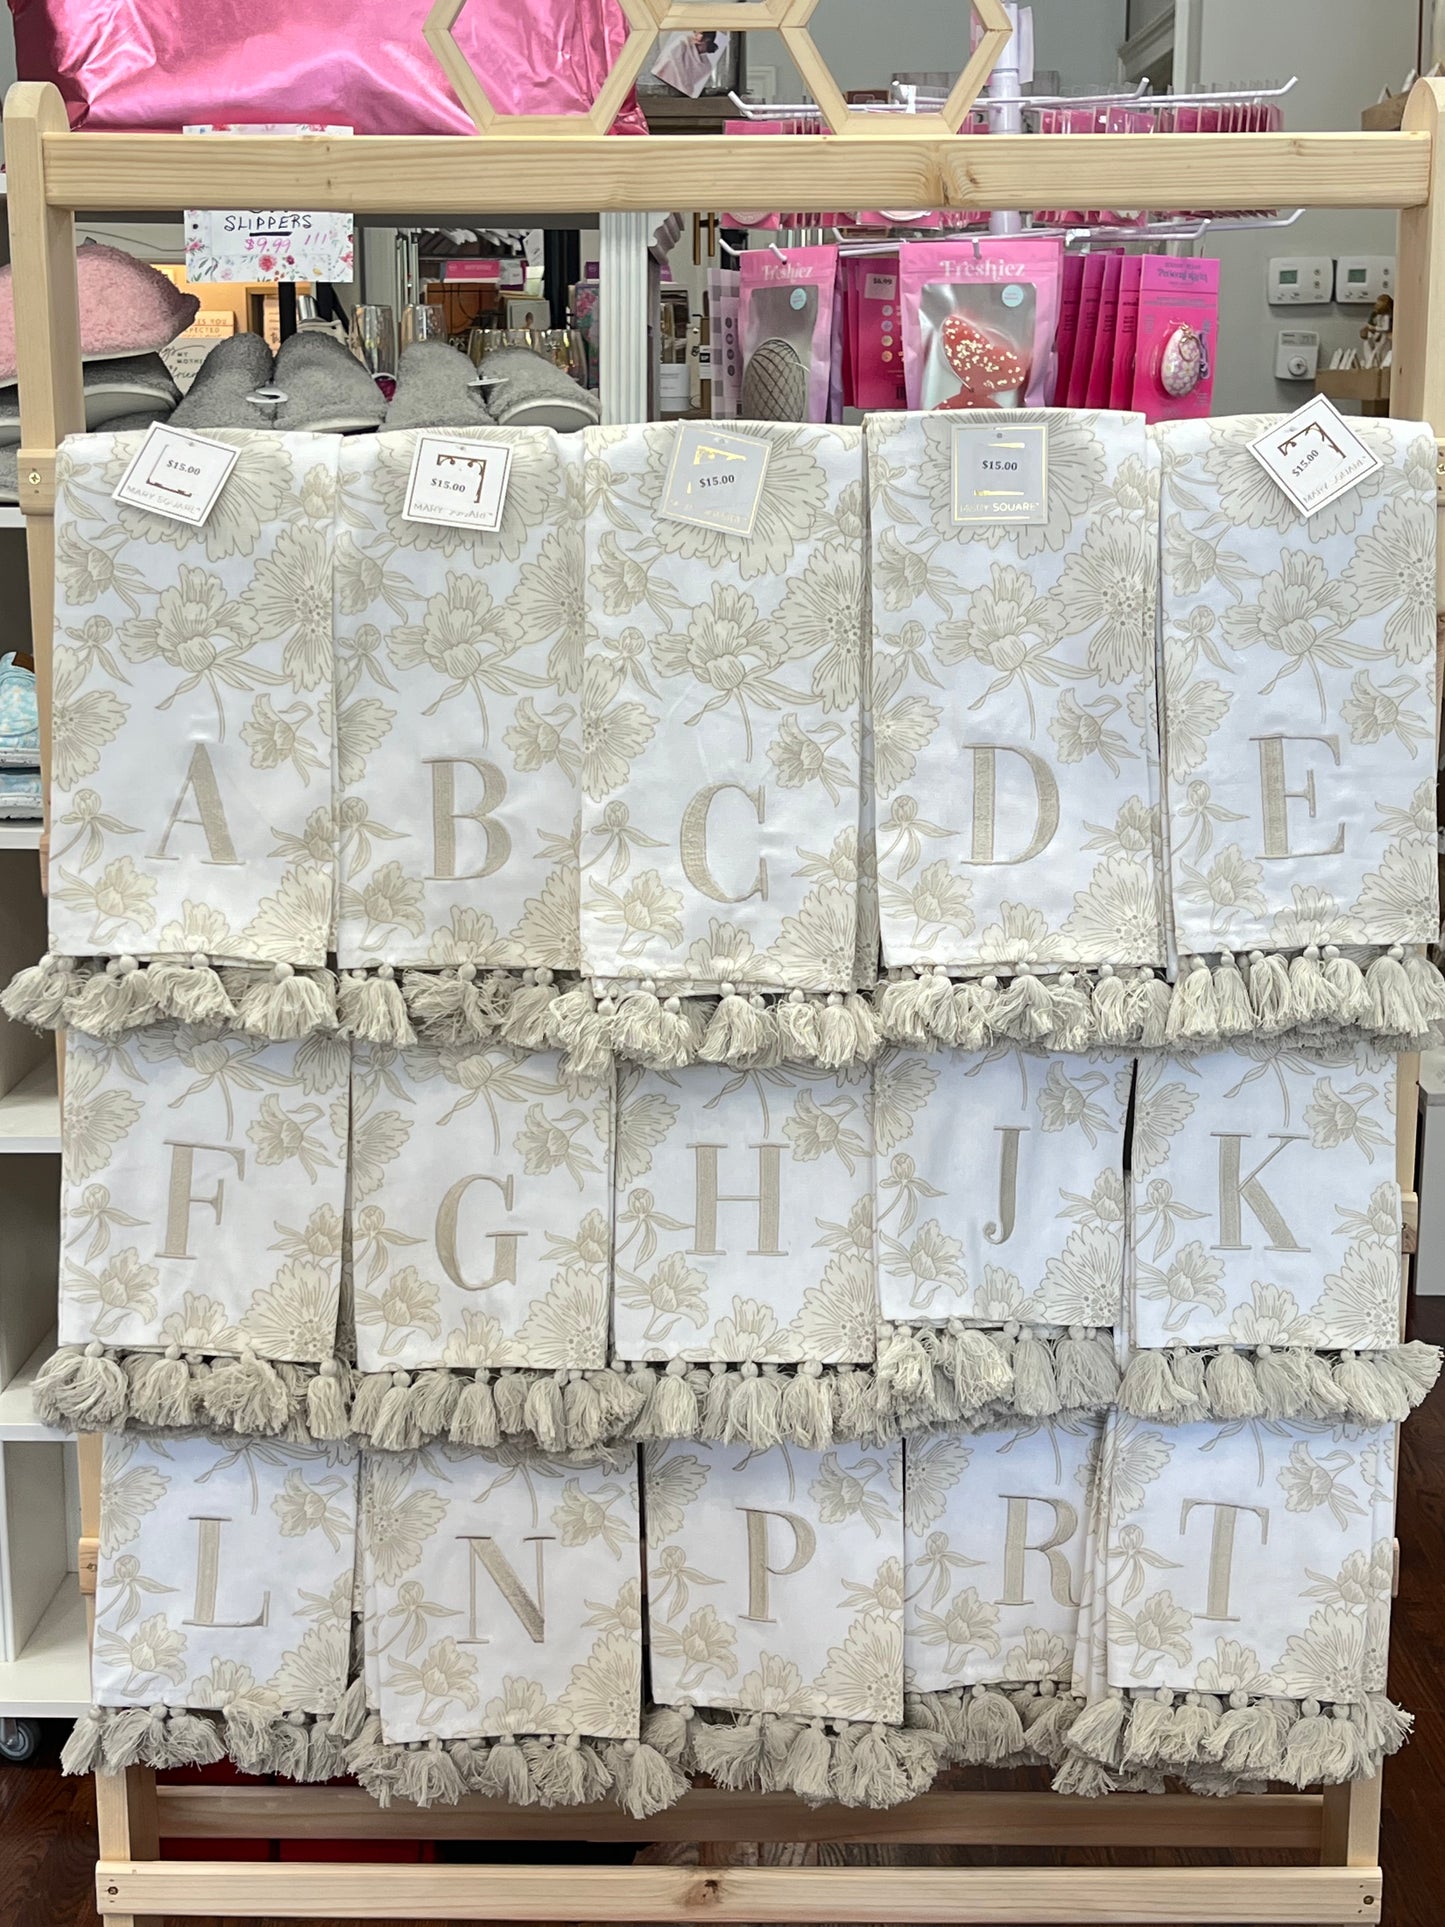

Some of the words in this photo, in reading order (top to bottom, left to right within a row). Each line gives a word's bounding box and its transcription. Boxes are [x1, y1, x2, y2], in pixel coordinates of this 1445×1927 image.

[224, 214, 312, 232] SLIPPERS
[244, 237, 291, 253] $9.99
[939, 259, 1025, 281] Freshiez
[166, 459, 201, 476] $15.00
[430, 478, 466, 493] $15.00
[699, 474, 735, 488] $15.00
[982, 460, 1018, 471] $15.00
[1291, 449, 1319, 478] $15.00
[145, 743, 246, 866] A
[422, 756, 511, 881] B
[681, 783, 769, 903] C
[961, 743, 1060, 865] D
[1249, 734, 1345, 860] E
[155, 1139, 246, 1260] F
[435, 1174, 529, 1291] G
[686, 1143, 789, 1257] H
[983, 1125, 1030, 1245] J
[1210, 1131, 1311, 1253] K
[182, 1515, 271, 1628] L
[454, 1535, 556, 1645] N
[735, 1506, 816, 1623] P
[997, 1494, 1080, 1608] R
[1179, 1498, 1271, 1622] T
